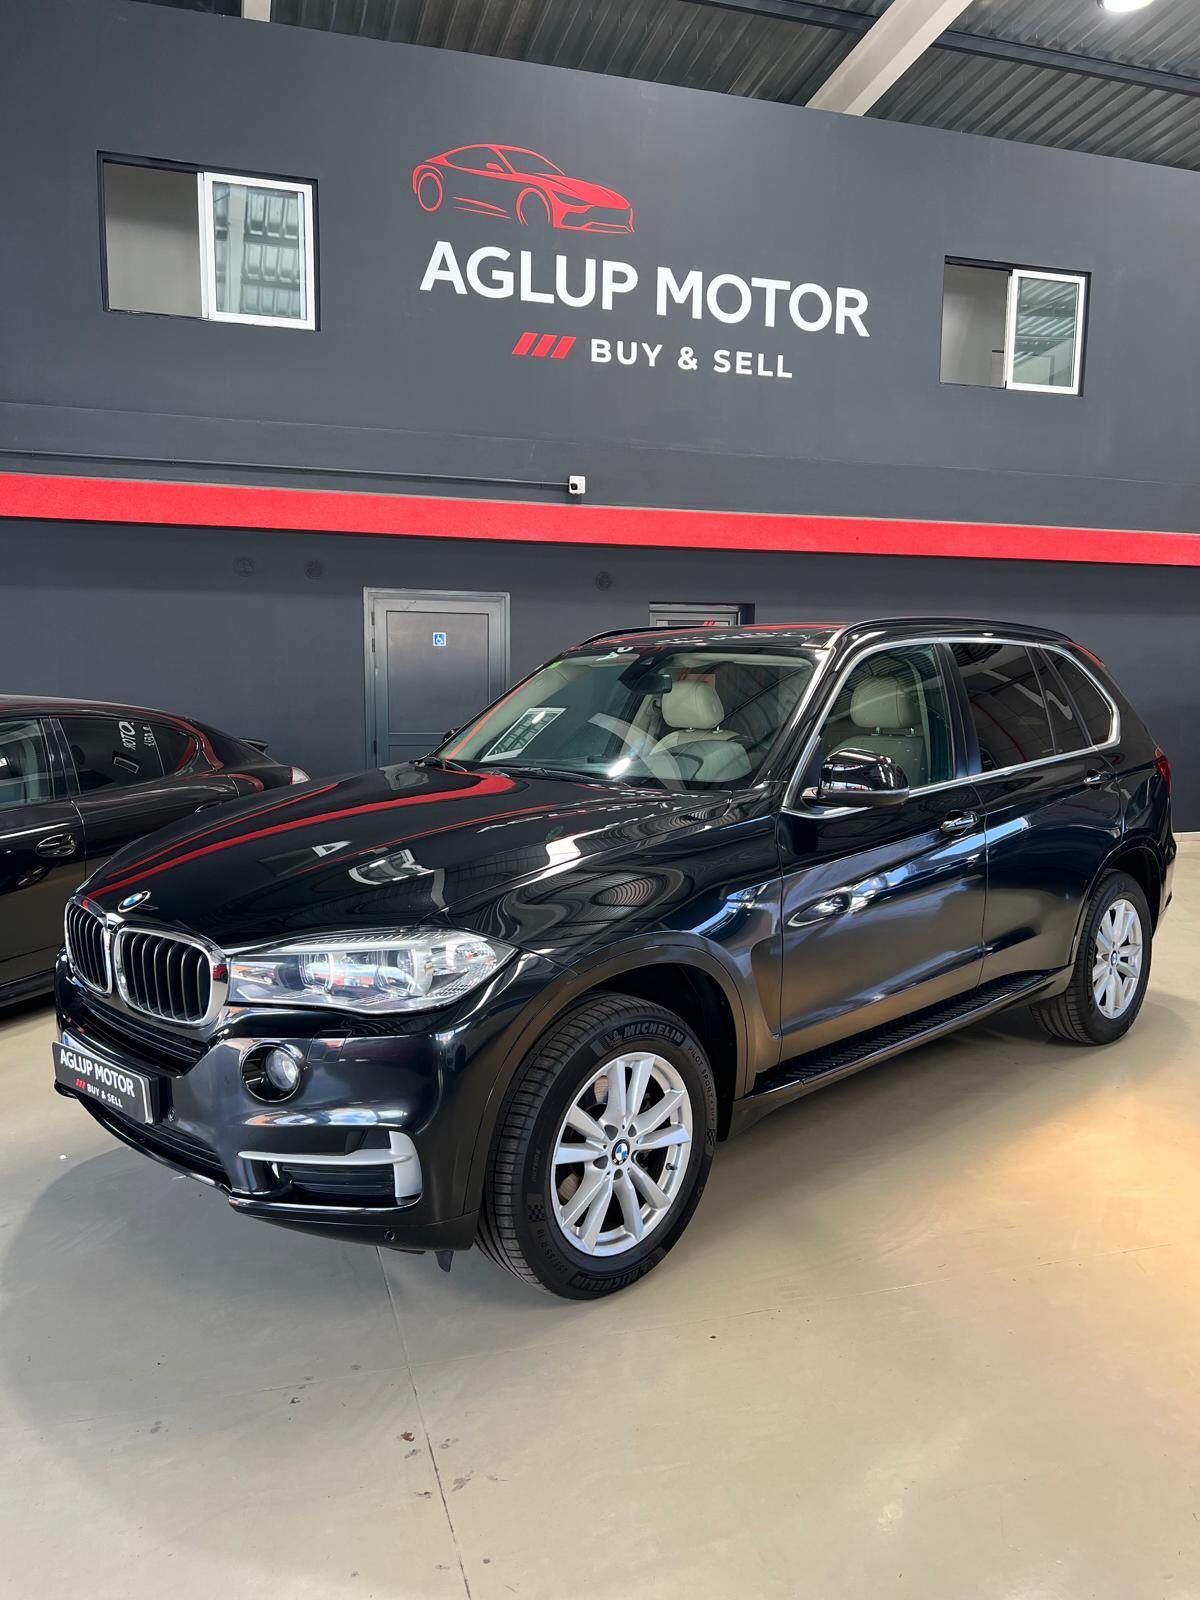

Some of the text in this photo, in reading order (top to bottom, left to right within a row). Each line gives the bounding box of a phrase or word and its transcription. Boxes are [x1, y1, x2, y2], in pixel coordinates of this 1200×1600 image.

[420, 240, 871, 338] AGLUP MOTOR
[591, 338, 793, 379] BUY & SELL
[624, 1022, 685, 1043] MICHELIN
[688, 1045, 704, 1066] PILOT
[60, 1048, 136, 1098] AGLUP MOTOR
[86, 1083, 123, 1108] BUY & SELL
